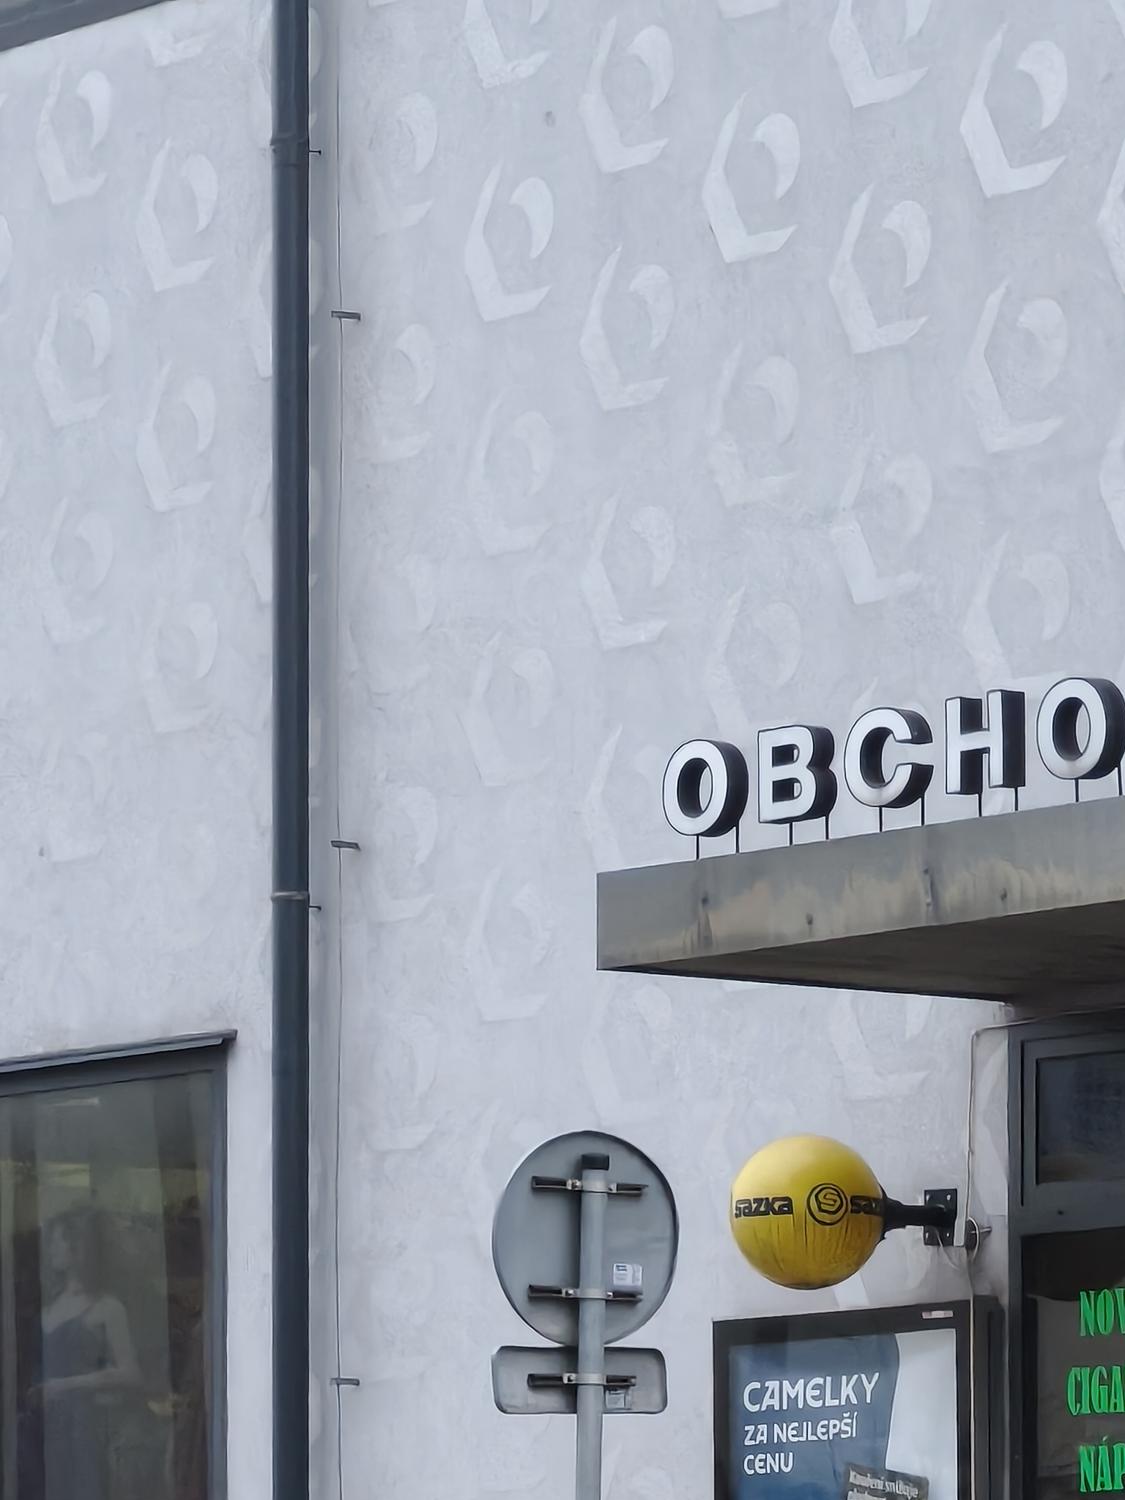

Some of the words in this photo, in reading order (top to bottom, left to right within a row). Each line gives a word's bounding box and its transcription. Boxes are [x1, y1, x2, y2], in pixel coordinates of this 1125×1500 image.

[742, 1371, 881, 1413] CAMELKY
[743, 1423, 767, 1446] ZA
[773, 1411, 859, 1444] NEJLEPŠÍ
[743, 1451, 794, 1475] CENU
